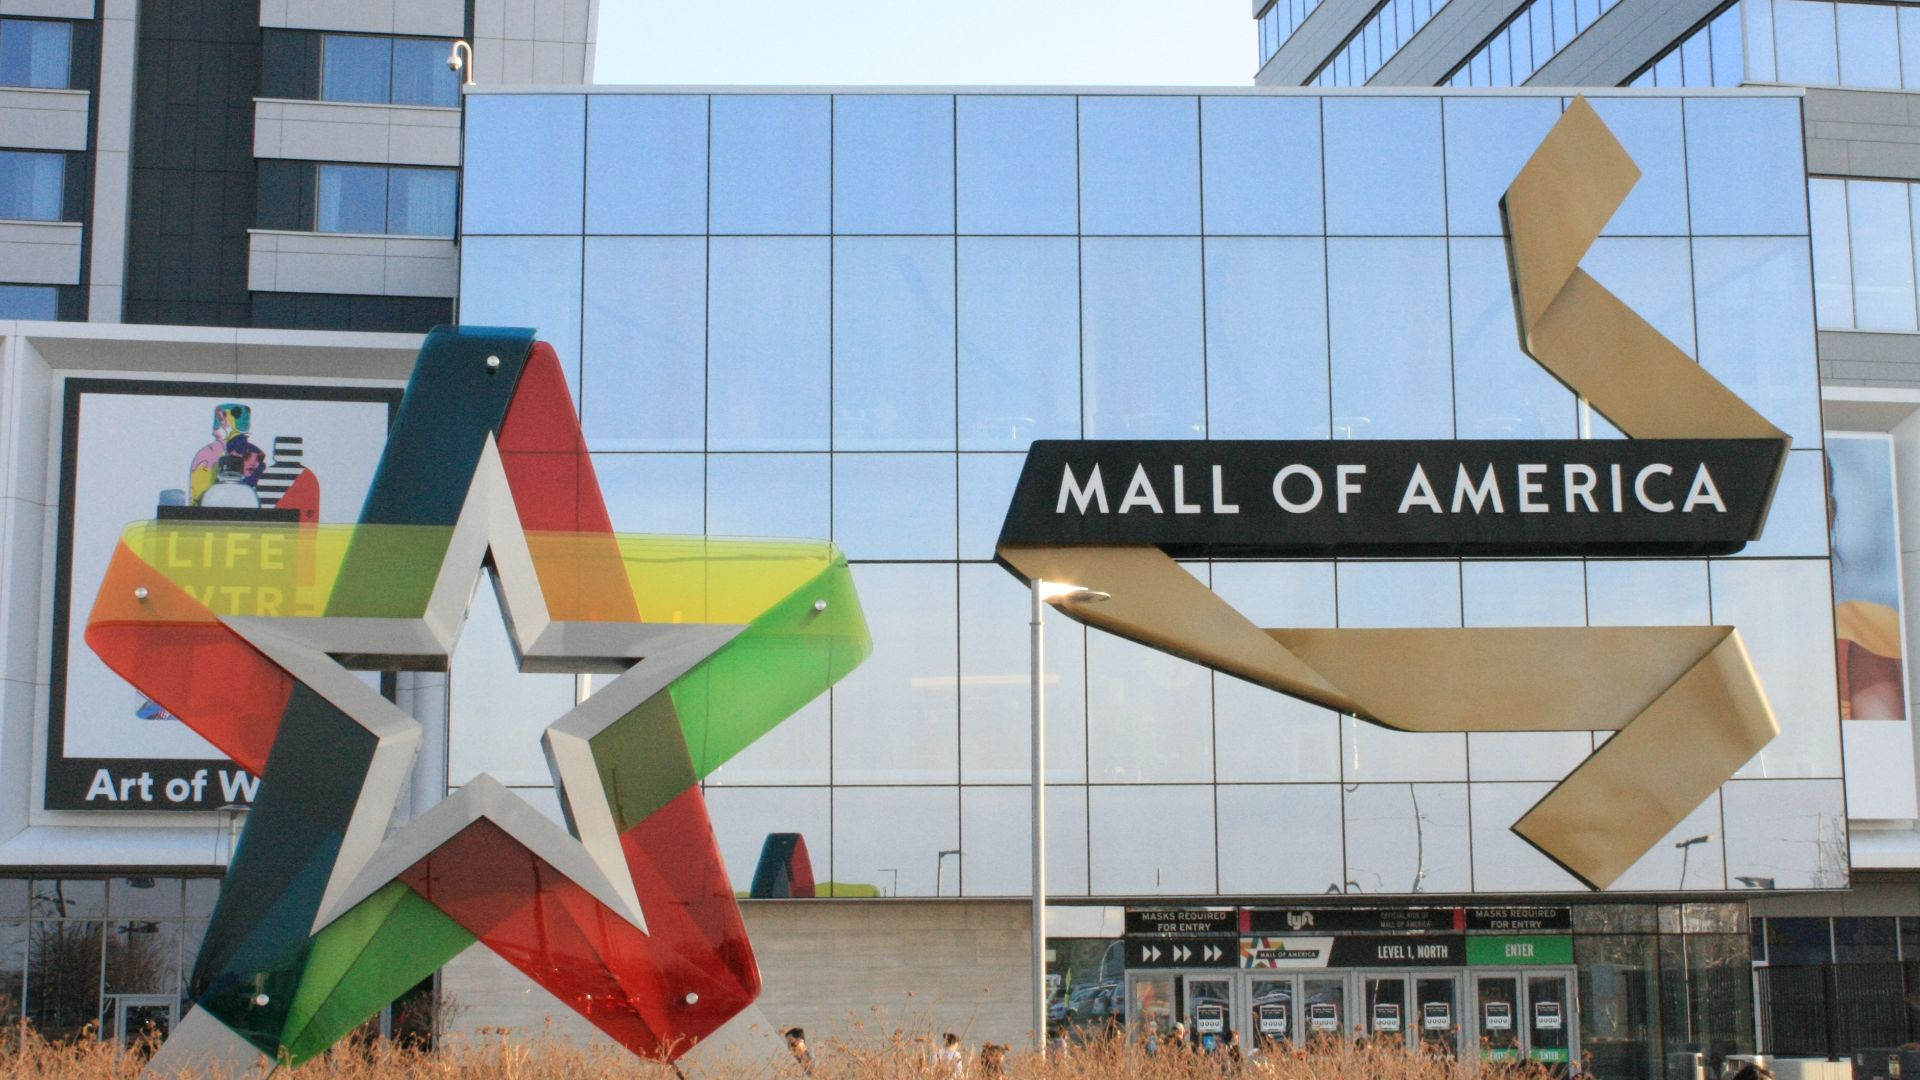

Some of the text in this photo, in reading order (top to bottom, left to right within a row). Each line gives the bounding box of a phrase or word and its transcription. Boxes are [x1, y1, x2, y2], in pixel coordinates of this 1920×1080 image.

[1055, 461, 1728, 515] MALL OF AMERICA
[168, 531, 286, 569] LIFE
[85, 768, 154, 802] Art
[165, 769, 208, 802] of
[1142, 912, 1226, 920] MASKS REQUIRED
[1475, 909, 1556, 918] MASKS REQUIRED
[1158, 923, 1211, 932] FOR ENTRY
[1491, 920, 1542, 929] FOR ENTRY
[1378, 945, 1448, 960] LEVEL 1, NORTH
[1505, 944, 1534, 957] ENTER
